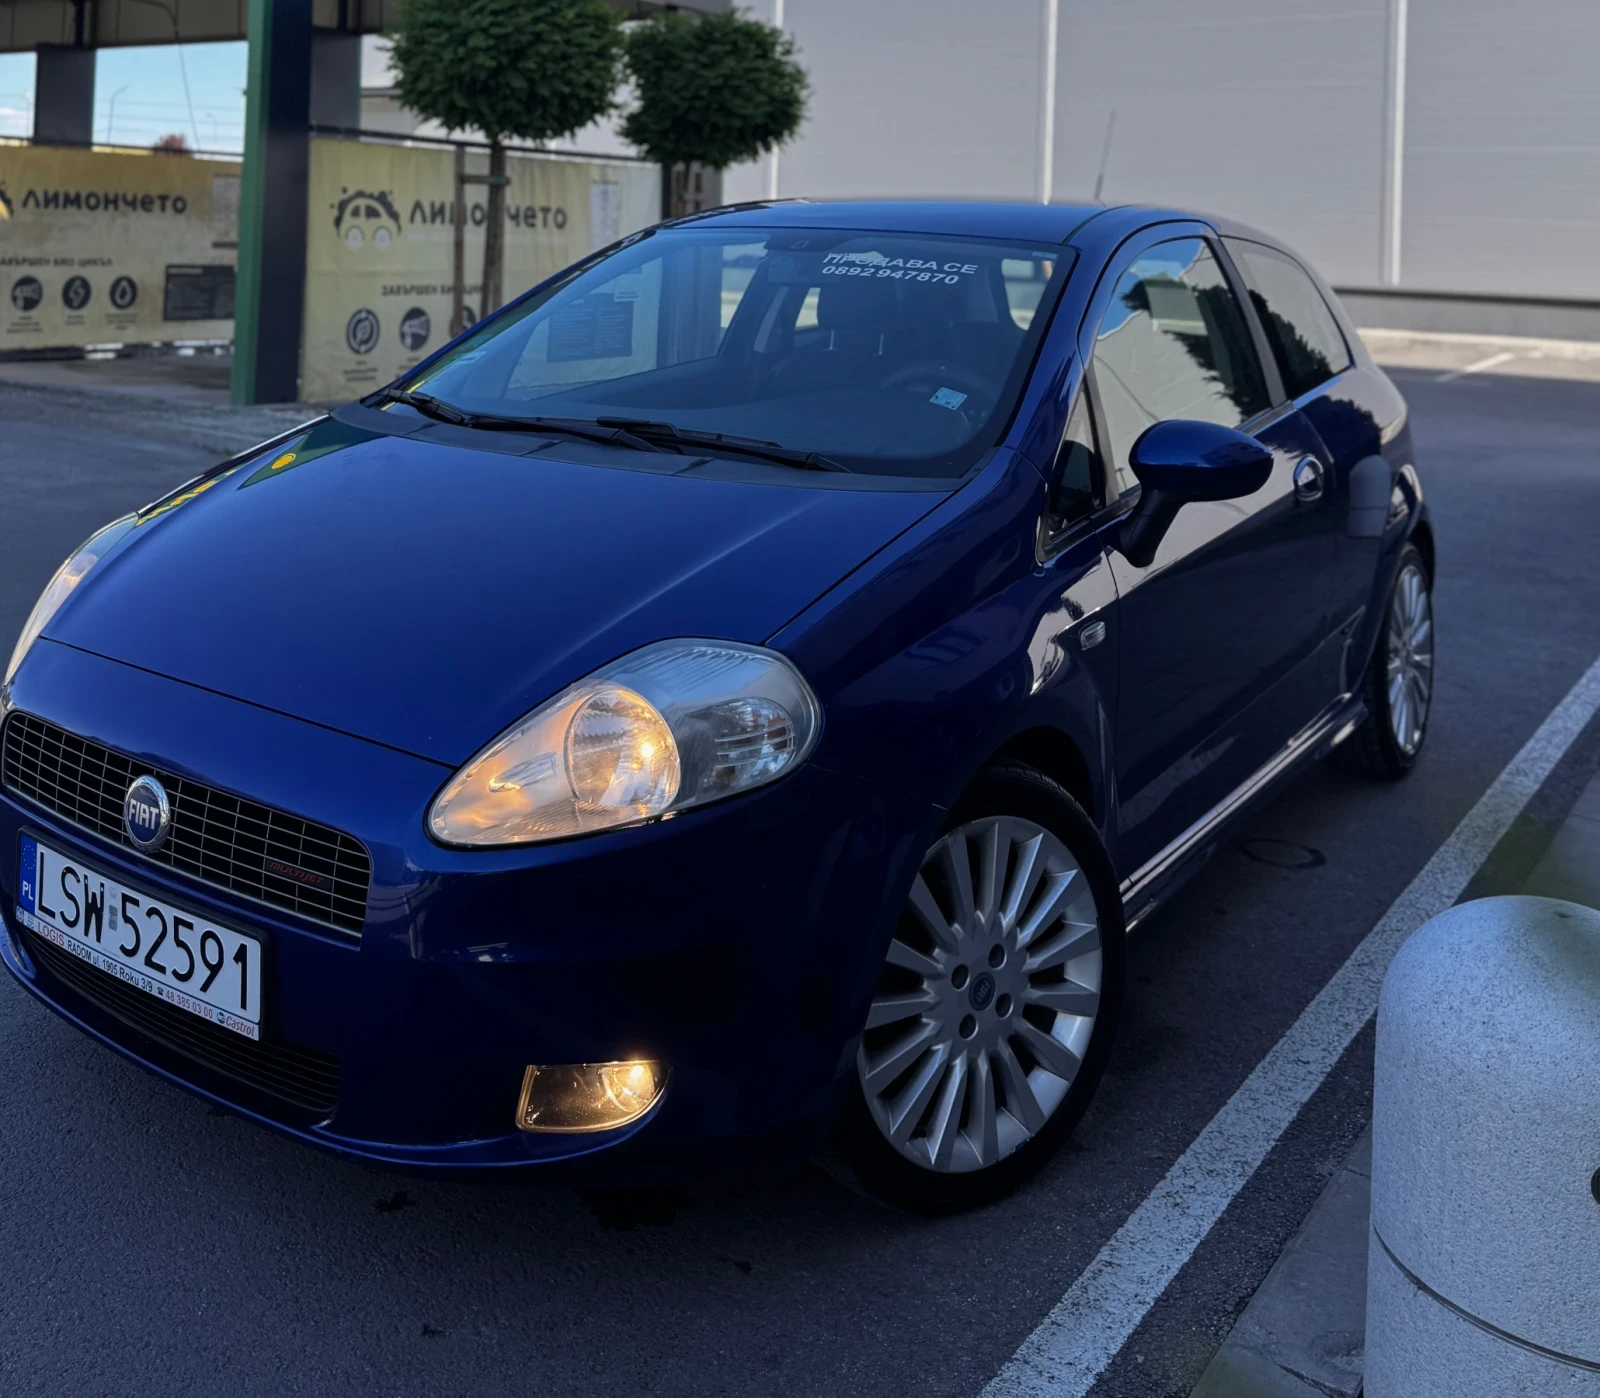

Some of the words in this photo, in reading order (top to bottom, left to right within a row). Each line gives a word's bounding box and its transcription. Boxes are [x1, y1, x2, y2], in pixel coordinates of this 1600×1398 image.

[822, 254, 938, 271] ПРОДАВА
[822, 265, 875, 277] 0892
[876, 268, 960, 285] 947870
[128, 798, 160, 830] FIAT
[22, 879, 34, 901] PL
[38, 851, 105, 944] LSW
[118, 891, 248, 1012] 52591
[37, 921, 65, 947] LOGIS
[67, 939, 92, 962] RADOM
[102, 958, 118, 976] 1905
[119, 969, 140, 987] Roku
[141, 977, 153, 993] 3/9
[165, 990, 175, 1003] 48
[203, 1006, 213, 1020] 00
[225, 1015, 255, 1038] Castrol
